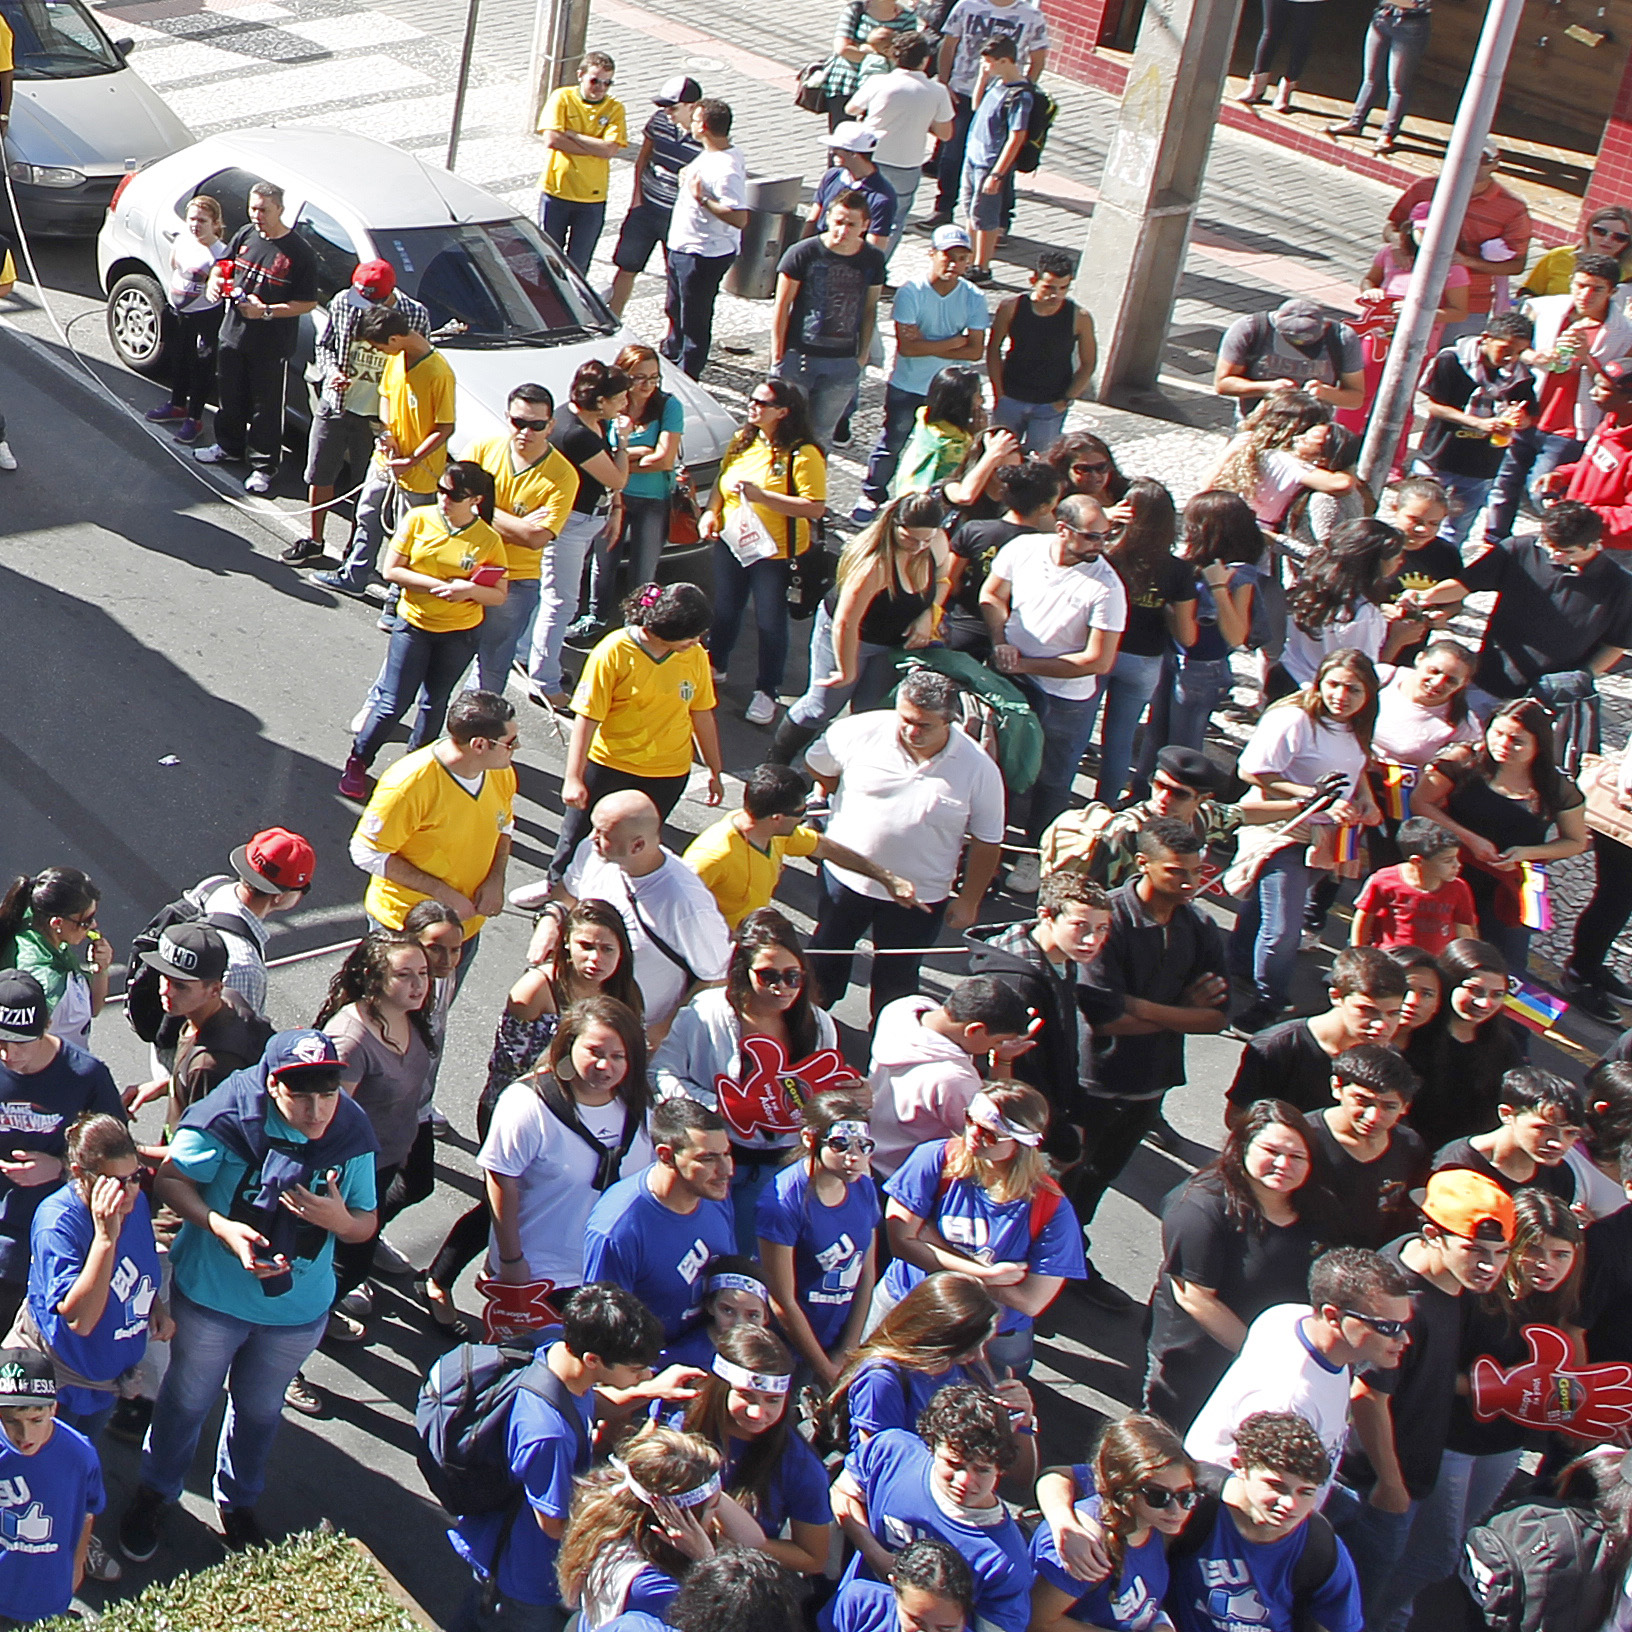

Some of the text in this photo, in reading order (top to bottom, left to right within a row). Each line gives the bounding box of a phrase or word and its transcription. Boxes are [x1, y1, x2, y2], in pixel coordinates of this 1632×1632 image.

[1, 1102, 33, 1115] VANS
[677, 1238, 709, 1285] EU
[815, 1233, 855, 1272] EU
[110, 1256, 139, 1303] EU
[1198, 1559, 1249, 1588] EU
